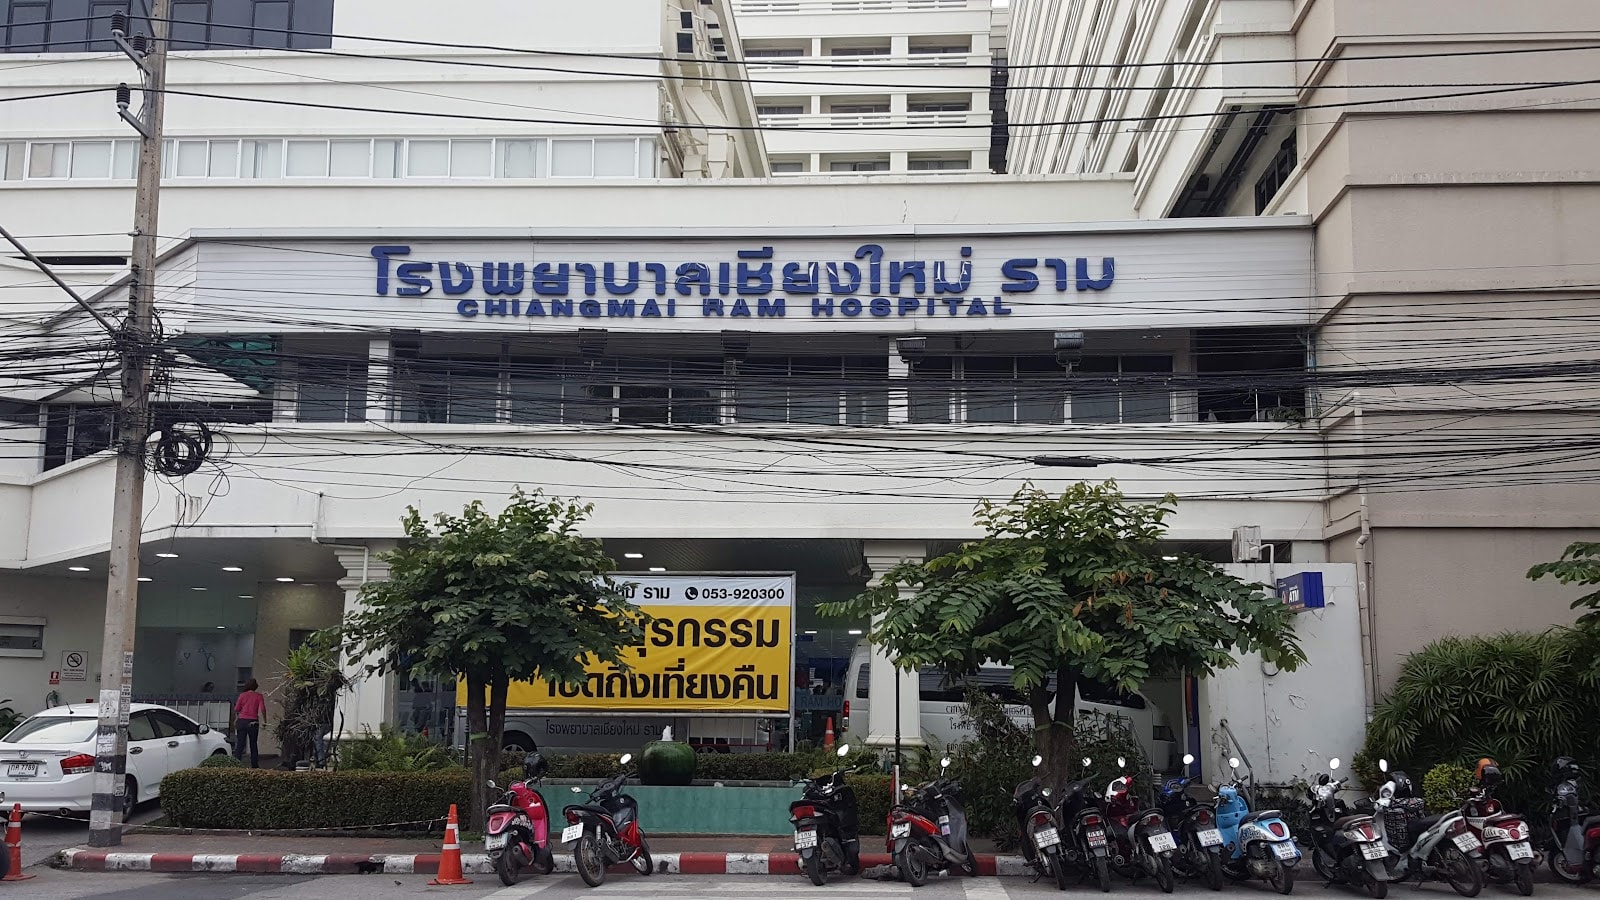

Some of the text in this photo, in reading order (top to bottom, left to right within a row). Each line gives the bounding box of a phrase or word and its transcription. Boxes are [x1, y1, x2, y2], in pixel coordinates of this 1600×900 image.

[371, 243, 1115, 296] โรงพยาบาลเชียงใหม่ ราม
[457, 296, 1012, 318] CHIANGMAI RAM HOSPITAL
[643, 586, 670, 599] ราม
[702, 587, 785, 600] 053-920300
[1288, 590, 1300, 603] ATM
